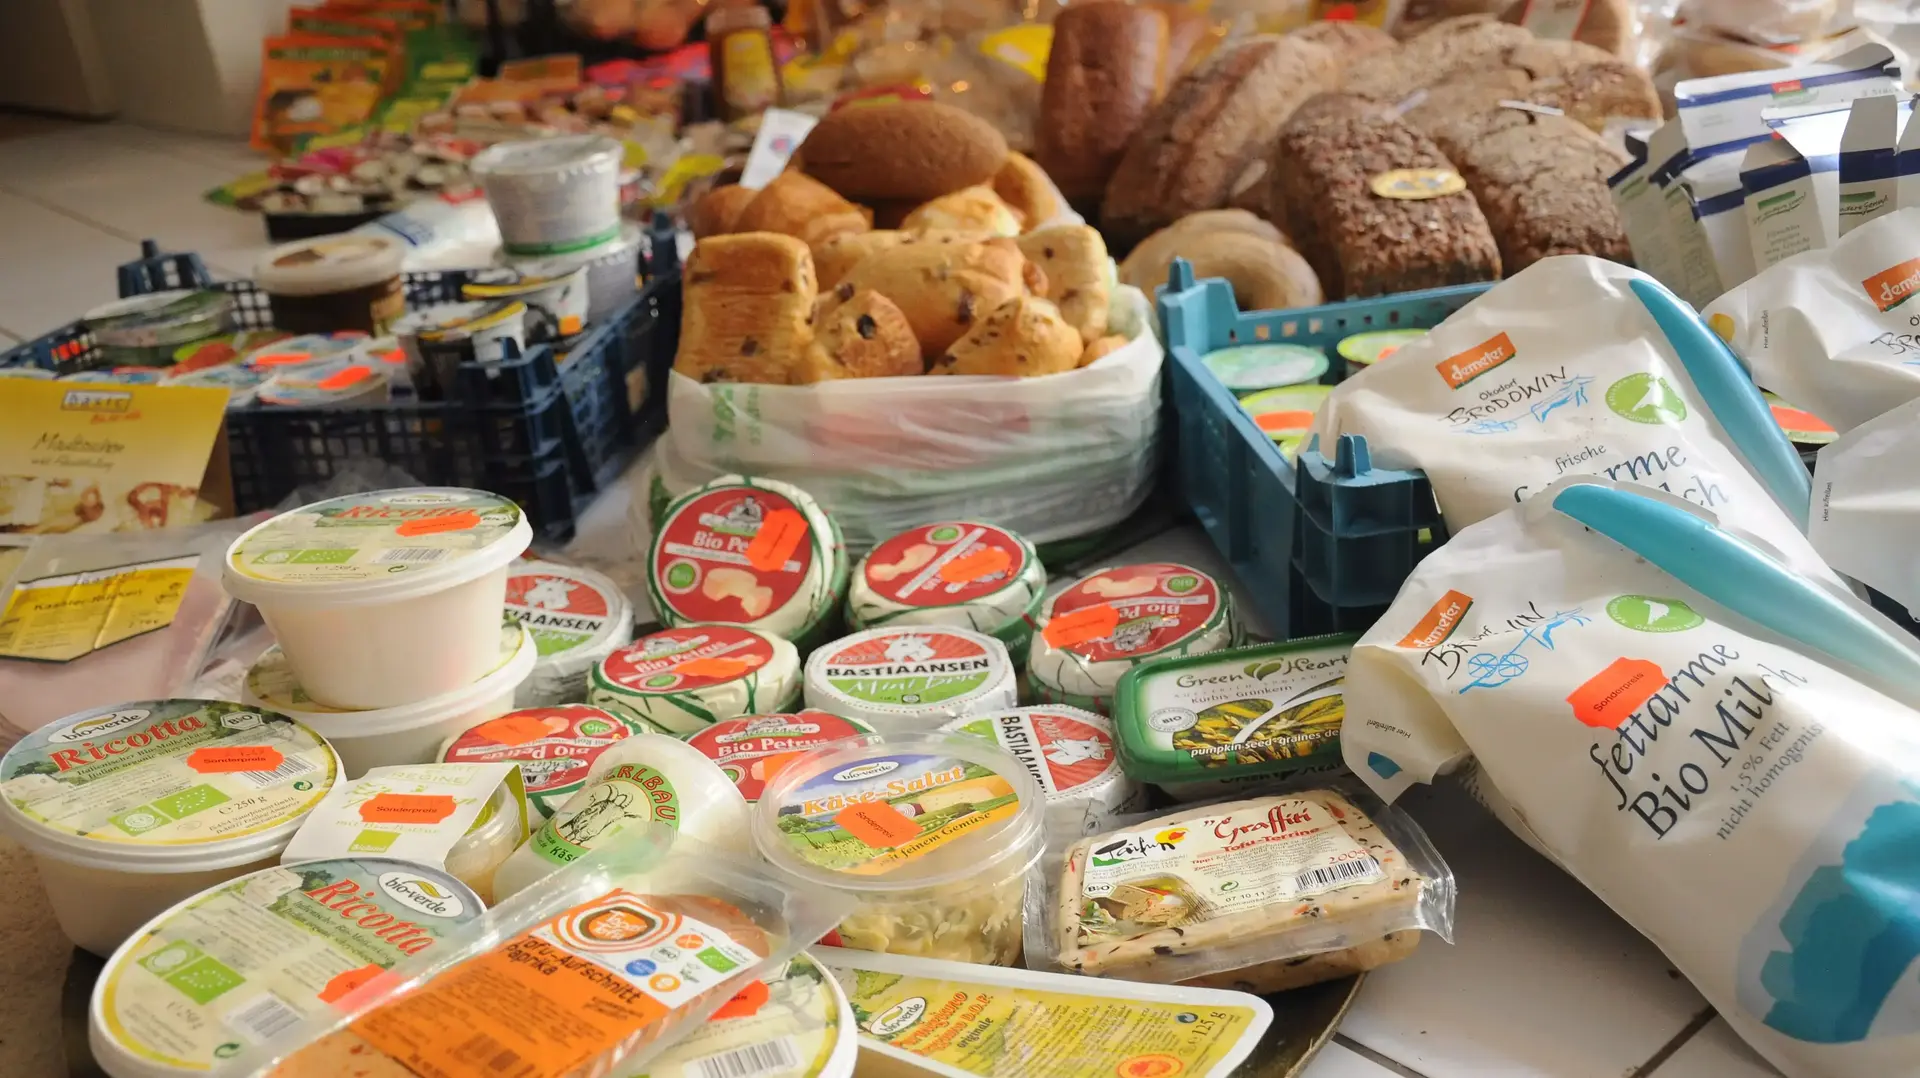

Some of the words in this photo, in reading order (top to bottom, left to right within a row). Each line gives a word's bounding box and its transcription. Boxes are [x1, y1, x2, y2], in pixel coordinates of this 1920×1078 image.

[1451, 346, 1505, 381] demeter
[1440, 366, 1566, 424] BRODOWIN
[1554, 443, 1607, 475] frische
[691, 530, 723, 550] Bio
[1147, 604, 1180, 615] Bio
[1413, 602, 1461, 648] demeter
[634, 658, 668, 674] Bio
[826, 658, 989, 677] BASTIAANSEN
[1176, 673, 1243, 689] Green
[1283, 655, 1348, 676] Heart
[1236, 685, 1293, 698] Grünkern
[1592, 672, 1645, 713] Sonderpreis
[61, 713, 142, 741] bio-verde
[227, 714, 253, 725] BIO
[1161, 715, 1183, 725] BIO
[1396, 728, 1412, 739] Hier
[1589, 643, 1740, 812] fettarme
[48, 714, 208, 773] Ricotta
[718, 741, 754, 757] Bio
[760, 737, 829, 751] Petrus
[1190, 742, 1242, 759] pumpkin
[1244, 738, 1273, 750] seed
[1278, 731, 1321, 746] graines
[1758, 719, 1791, 753] Fett
[202, 756, 267, 765] Sonderpreis
[1627, 762, 1709, 841] Bio
[1690, 662, 1808, 769] Milch
[87, 764, 120, 780] Italian
[842, 763, 893, 781] bio-verde
[233, 797, 256, 811] 250
[802, 765, 965, 817] Käse-Salat
[375, 805, 438, 815] Sonderpreis
[1715, 794, 1754, 842] nicht
[855, 810, 895, 839] Sonderpreis
[900, 834, 941, 860] feinem
[940, 811, 991, 836] Gemüse
[1094, 836, 1176, 860] Taifun
[1220, 827, 1320, 853] Tofu-Terrine
[384, 877, 447, 915] bio-verde
[1087, 885, 1110, 893] BIO
[304, 878, 437, 957] Ricotta
[502, 943, 560, 976] Paprika
[527, 934, 642, 1005] Tofu-Aufschnitt
[879, 1001, 923, 1033] bio-verde
[1191, 1018, 1216, 1037] 125
[956, 1016, 994, 1049] originale
